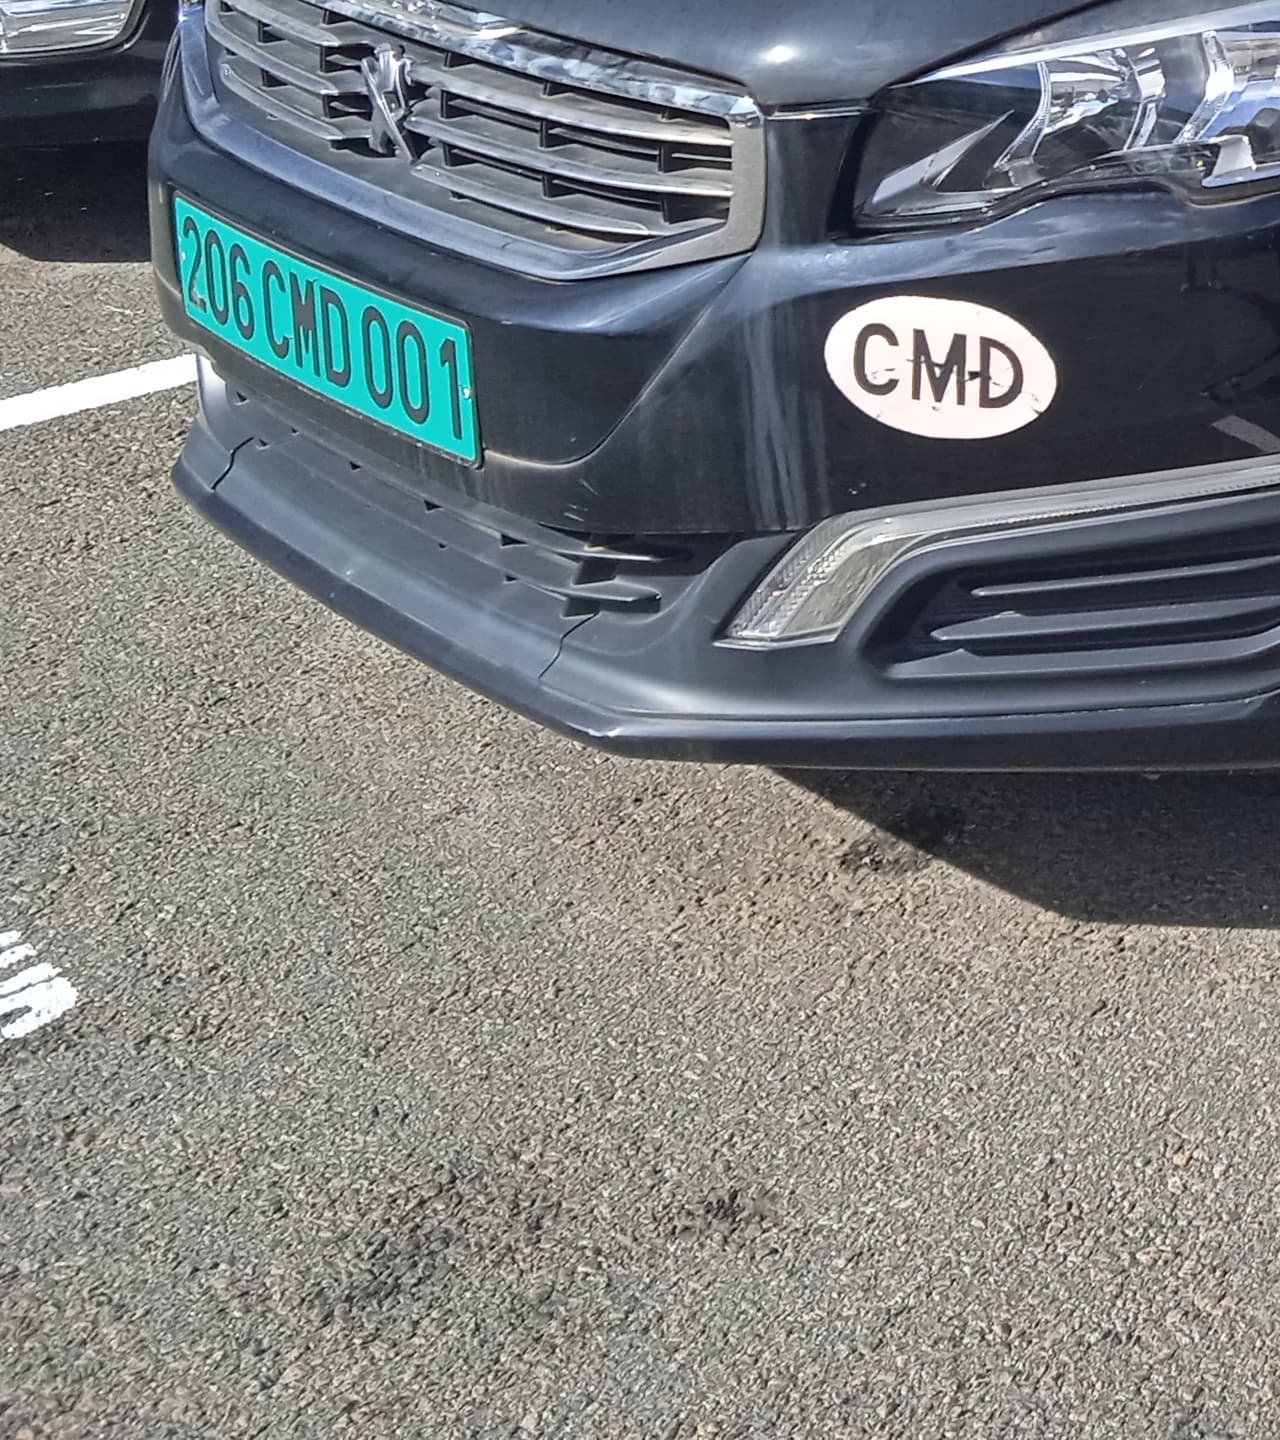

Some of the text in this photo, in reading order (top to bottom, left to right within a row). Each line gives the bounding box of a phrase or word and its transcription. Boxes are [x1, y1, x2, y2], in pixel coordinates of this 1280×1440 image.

[183, 215, 463, 441] 206 CMD 001
[853, 322, 1024, 409] CMD
